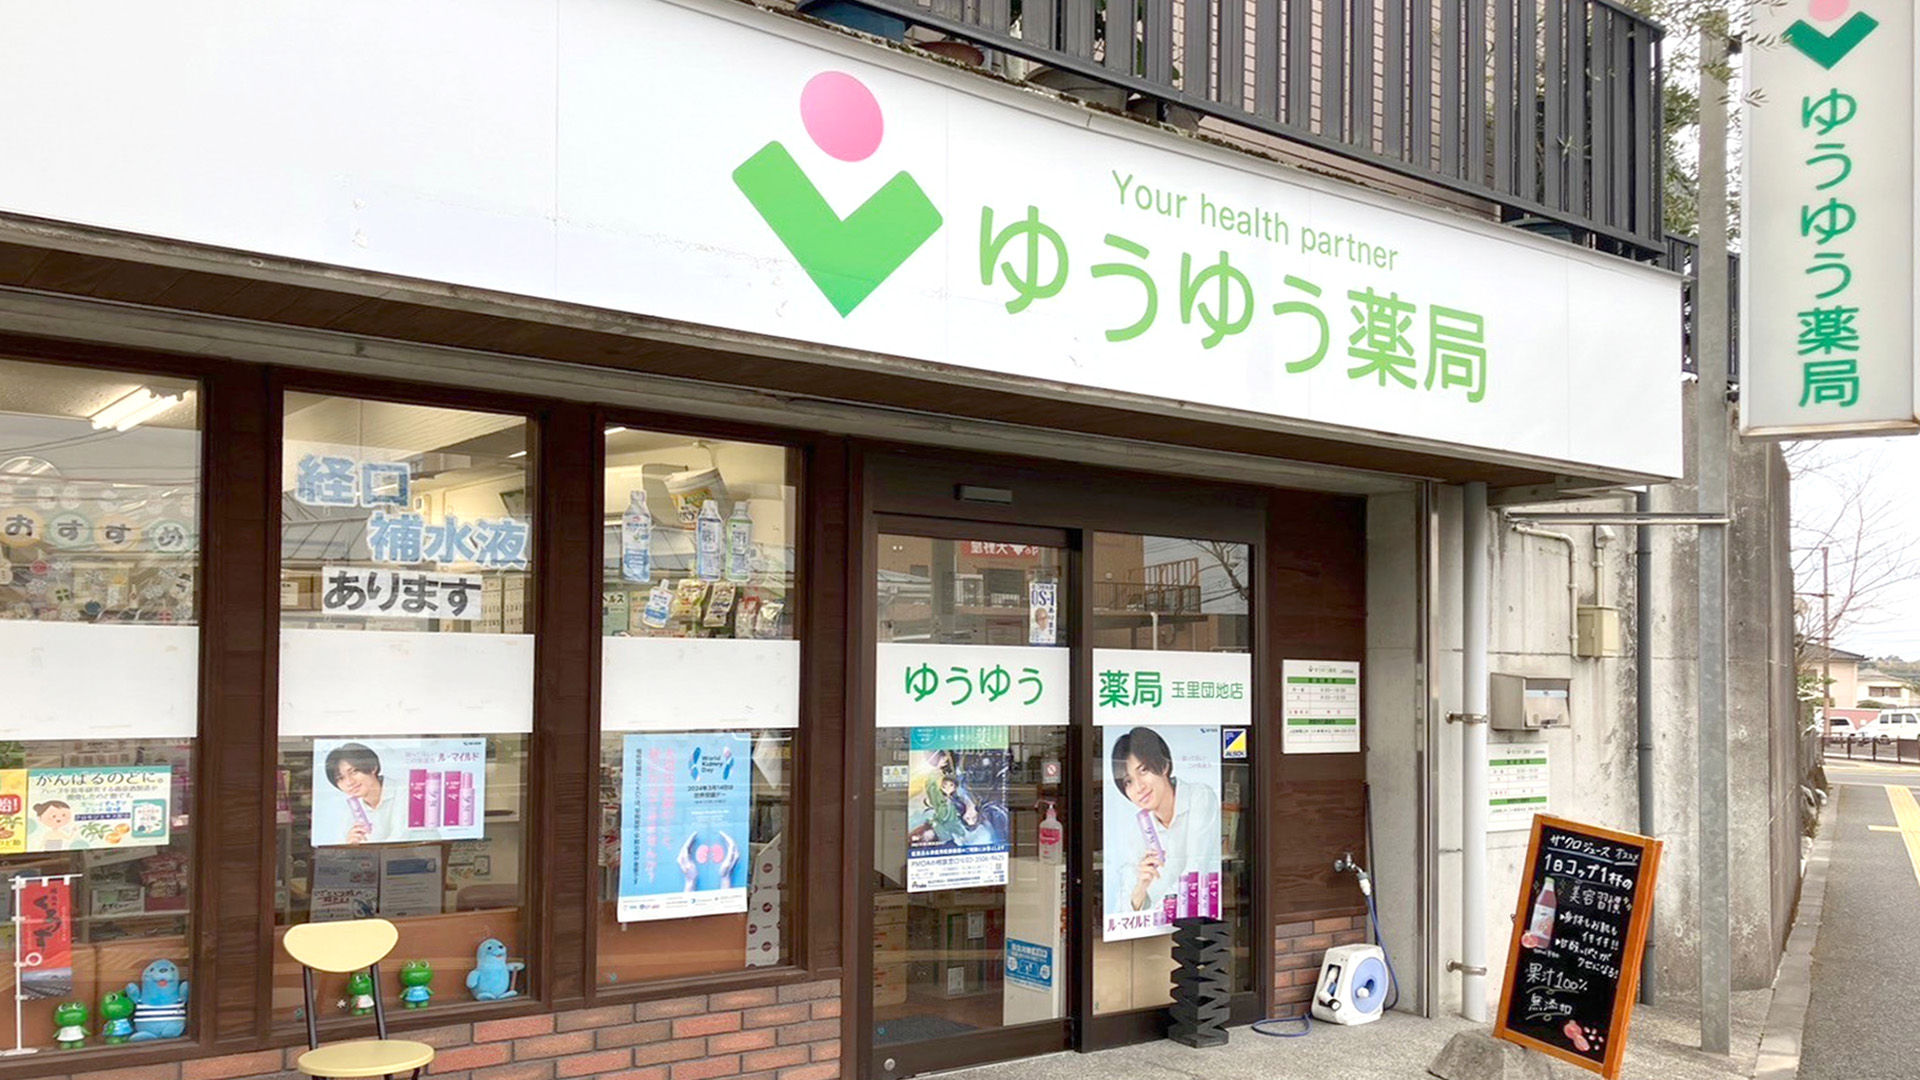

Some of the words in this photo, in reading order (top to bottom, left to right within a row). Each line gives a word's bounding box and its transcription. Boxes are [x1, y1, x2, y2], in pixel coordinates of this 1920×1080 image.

[1111, 169, 1188, 220] Your
[1200, 191, 1290, 246] health
[1300, 222, 1399, 272] partner
[1797, 87, 1861, 409] ゆうゆう薬局
[977, 203, 1489, 404] ゆうゆう薬局
[296, 453, 411, 508] 経口
[4, 513, 185, 547] おすすめ
[367, 510, 532, 570] 補水液
[323, 570, 481, 617] あります
[904, 662, 1045, 706] ゆうゆう
[1098, 669, 1163, 709] 薬局
[1171, 680, 1244, 700] 玉里団地店
[36, 772, 165, 787] がんばるのどに。
[1526, 962, 1589, 991] 果汁100%
[1528, 992, 1574, 1015] 無添加
